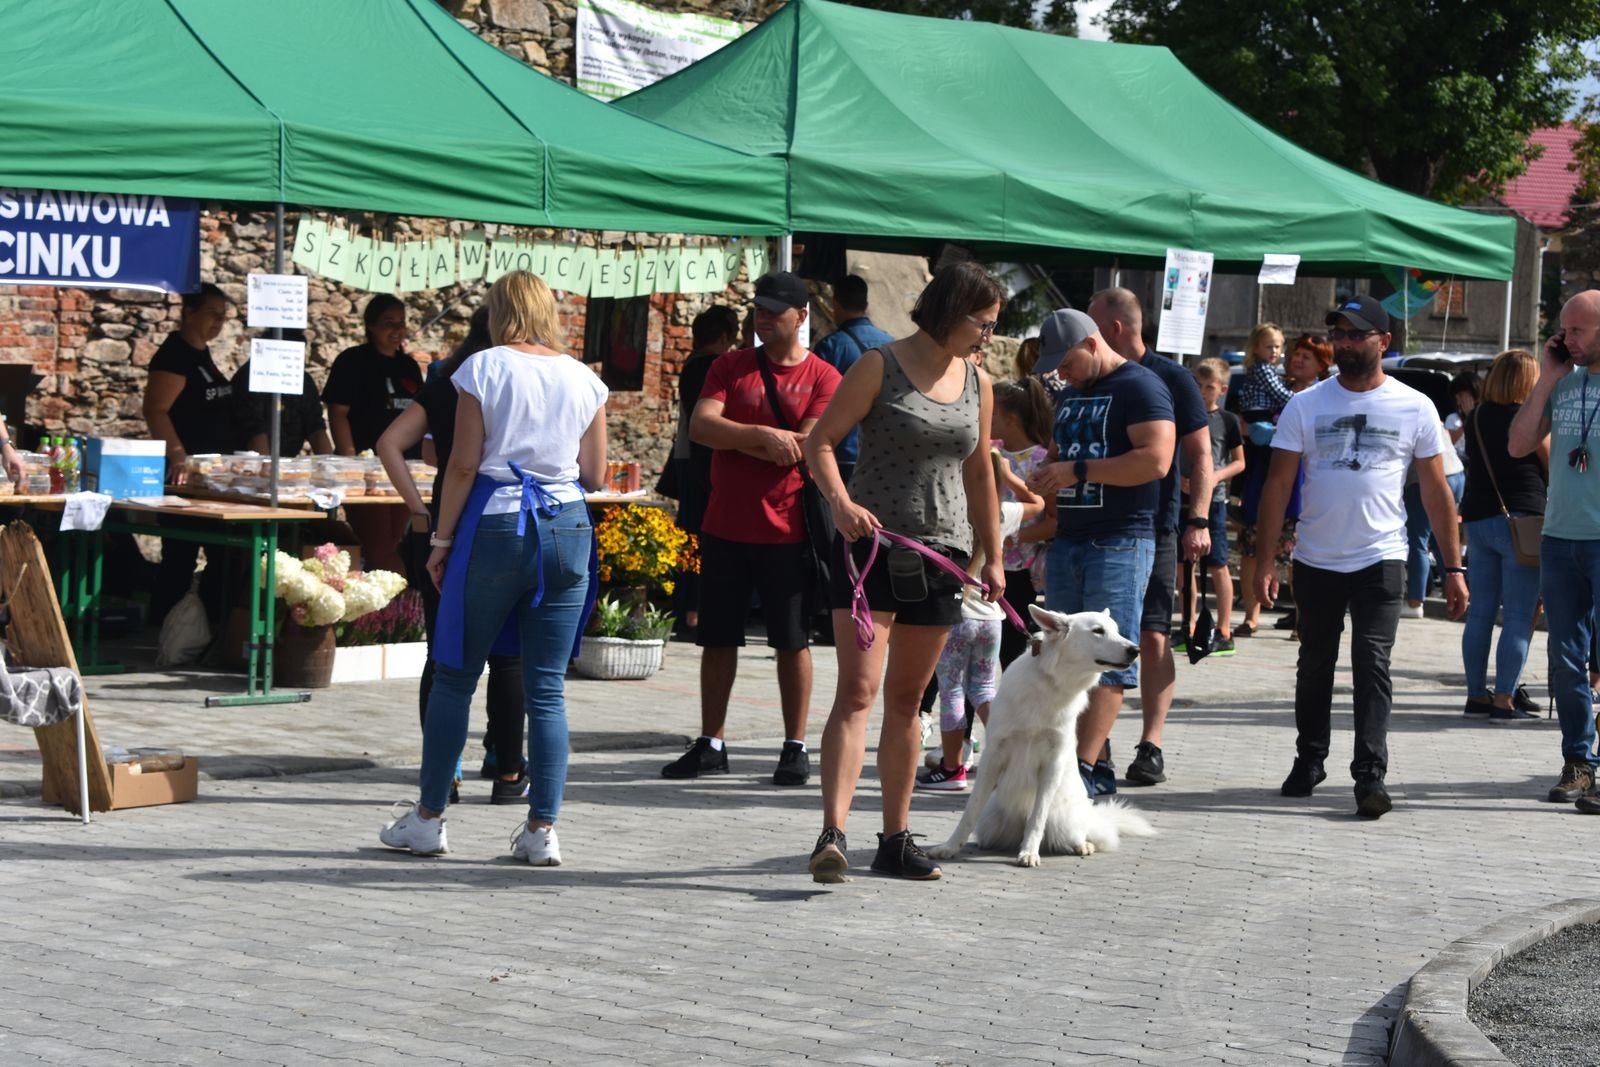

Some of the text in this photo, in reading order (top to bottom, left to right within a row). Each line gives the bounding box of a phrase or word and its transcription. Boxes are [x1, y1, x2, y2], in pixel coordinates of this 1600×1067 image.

[618, 32, 652, 45] wykopów
[0, 188, 171, 228] STAWOWA
[0, 230, 121, 278] CINKU
[303, 232, 448, 278] SZKOŁA
[494, 244, 765, 284] WOJCIESZYCACH
[205, 387, 217, 401] SP
[1556, 387, 1582, 406] JEAN
